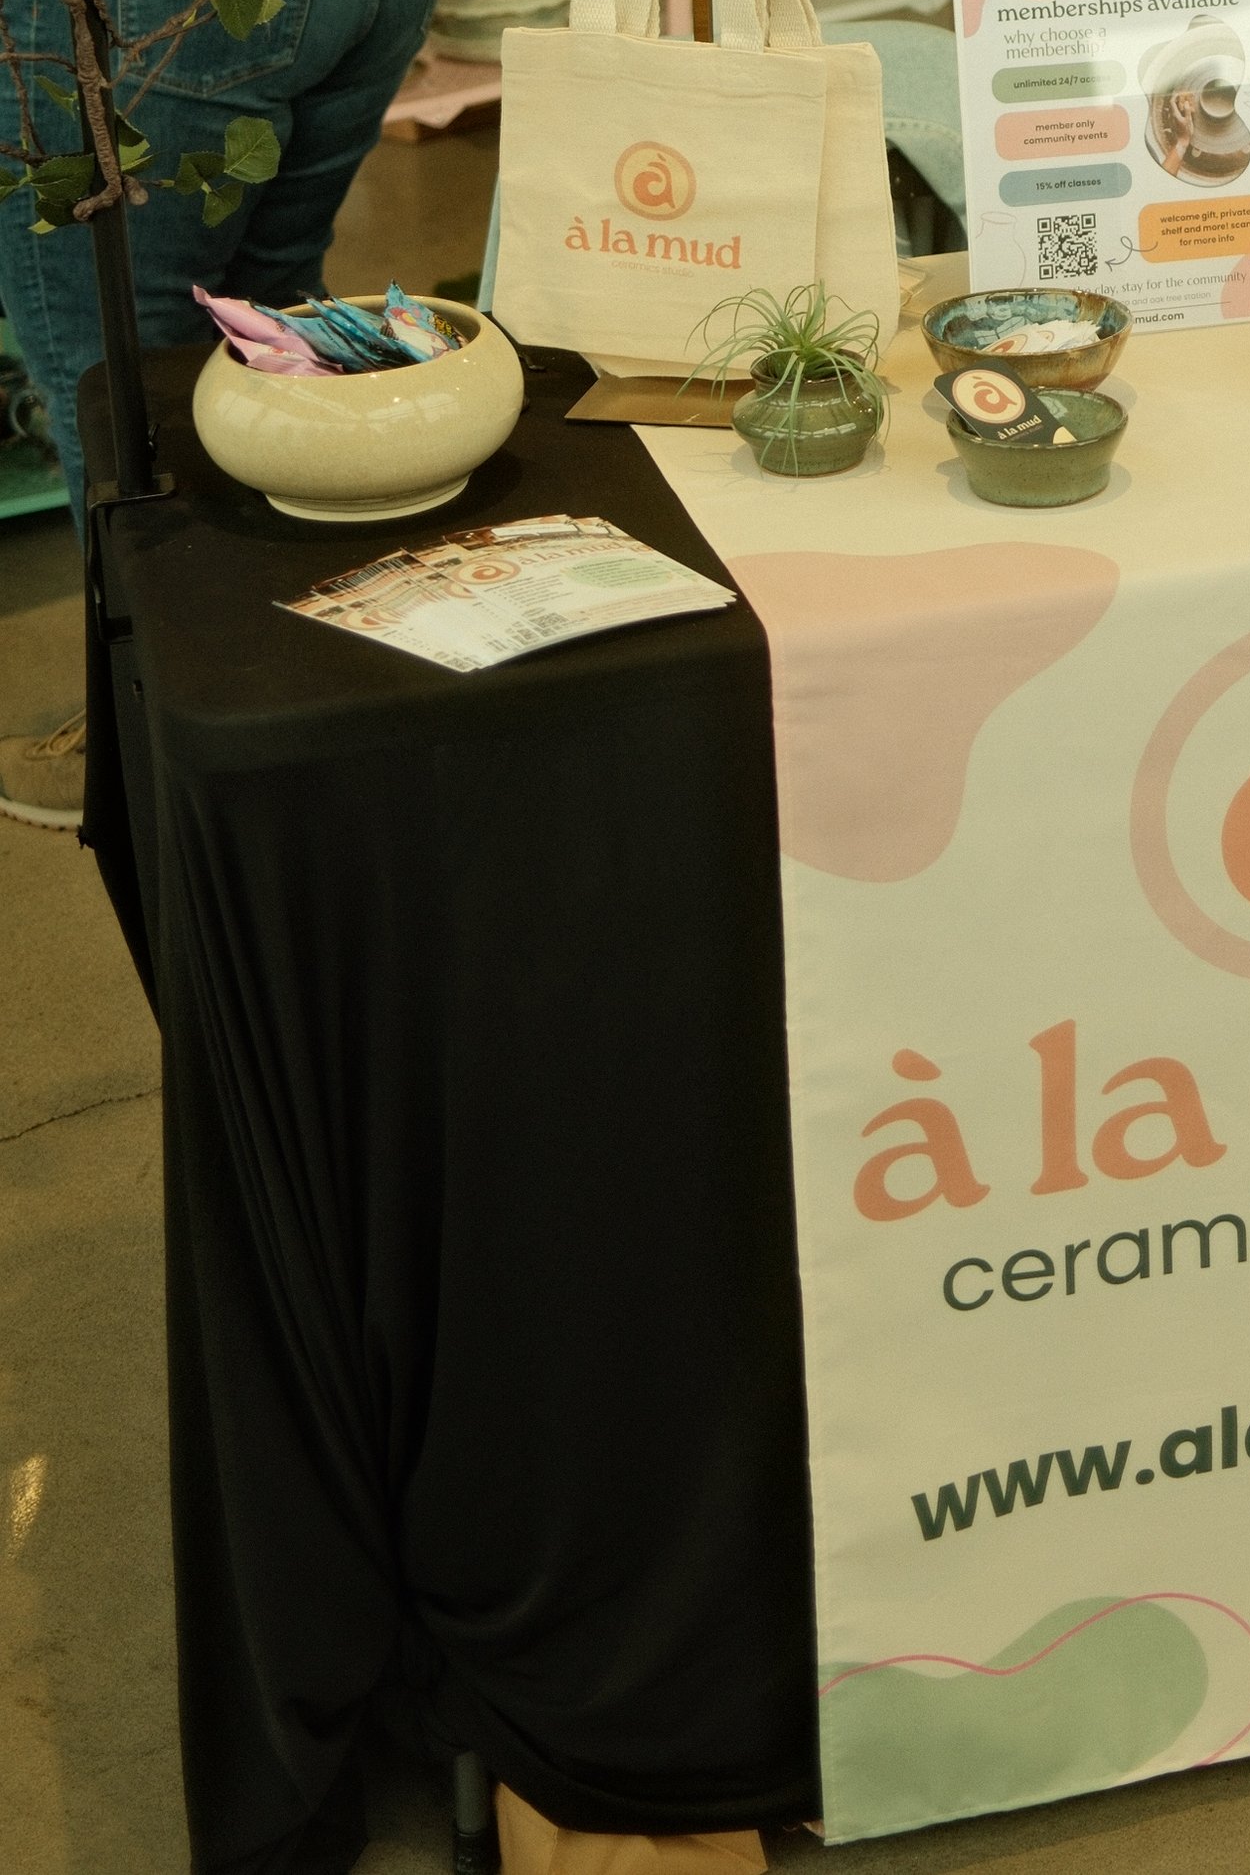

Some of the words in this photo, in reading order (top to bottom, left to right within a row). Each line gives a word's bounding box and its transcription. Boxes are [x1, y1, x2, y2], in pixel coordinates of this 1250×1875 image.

[1003, 29, 1036, 47] why
[1039, 27, 1094, 44] choose
[1098, 27, 1107, 39] a
[1005, 39, 1107, 61] membership?
[1013, 76, 1058, 90] unlimited
[1059, 74, 1078, 86] 24/7
[1035, 121, 1074, 132] member
[1075, 119, 1096, 130] only
[1023, 133, 1077, 145] community
[1077, 130, 1109, 141] events
[1035, 181, 1053, 191] 15%
[1054, 178, 1067, 189] off
[1067, 177, 1102, 188] classes
[1159, 213, 1200, 225] welcome
[1201, 210, 1219, 223] gift,
[1161, 223, 1183, 236] shelf
[1183, 223, 1202, 234] and
[1202, 222, 1229, 233] more!
[564, 216, 592, 252] à
[599, 218, 639, 256] la
[644, 232, 742, 271] mud
[1178, 237, 1193, 247] for
[1193, 236, 1217, 246] more
[1217, 233, 1235, 244] info
[1095, 283, 1119, 296] clay,
[1121, 281, 1143, 295] stay
[1145, 278, 1163, 290] for
[1164, 276, 1185, 288] the
[1186, 271, 1248, 287] community
[1183, 290, 1212, 302] station
[1134, 311, 1185, 325] mud.com
[997, 430, 1008, 440] à
[1003, 427, 1018, 436] la
[1016, 414, 1042, 431] mud
[533, 550, 566, 562] la
[565, 540, 624, 557] mud
[852, 1047, 991, 1223] à
[1028, 1018, 1228, 1196] la
